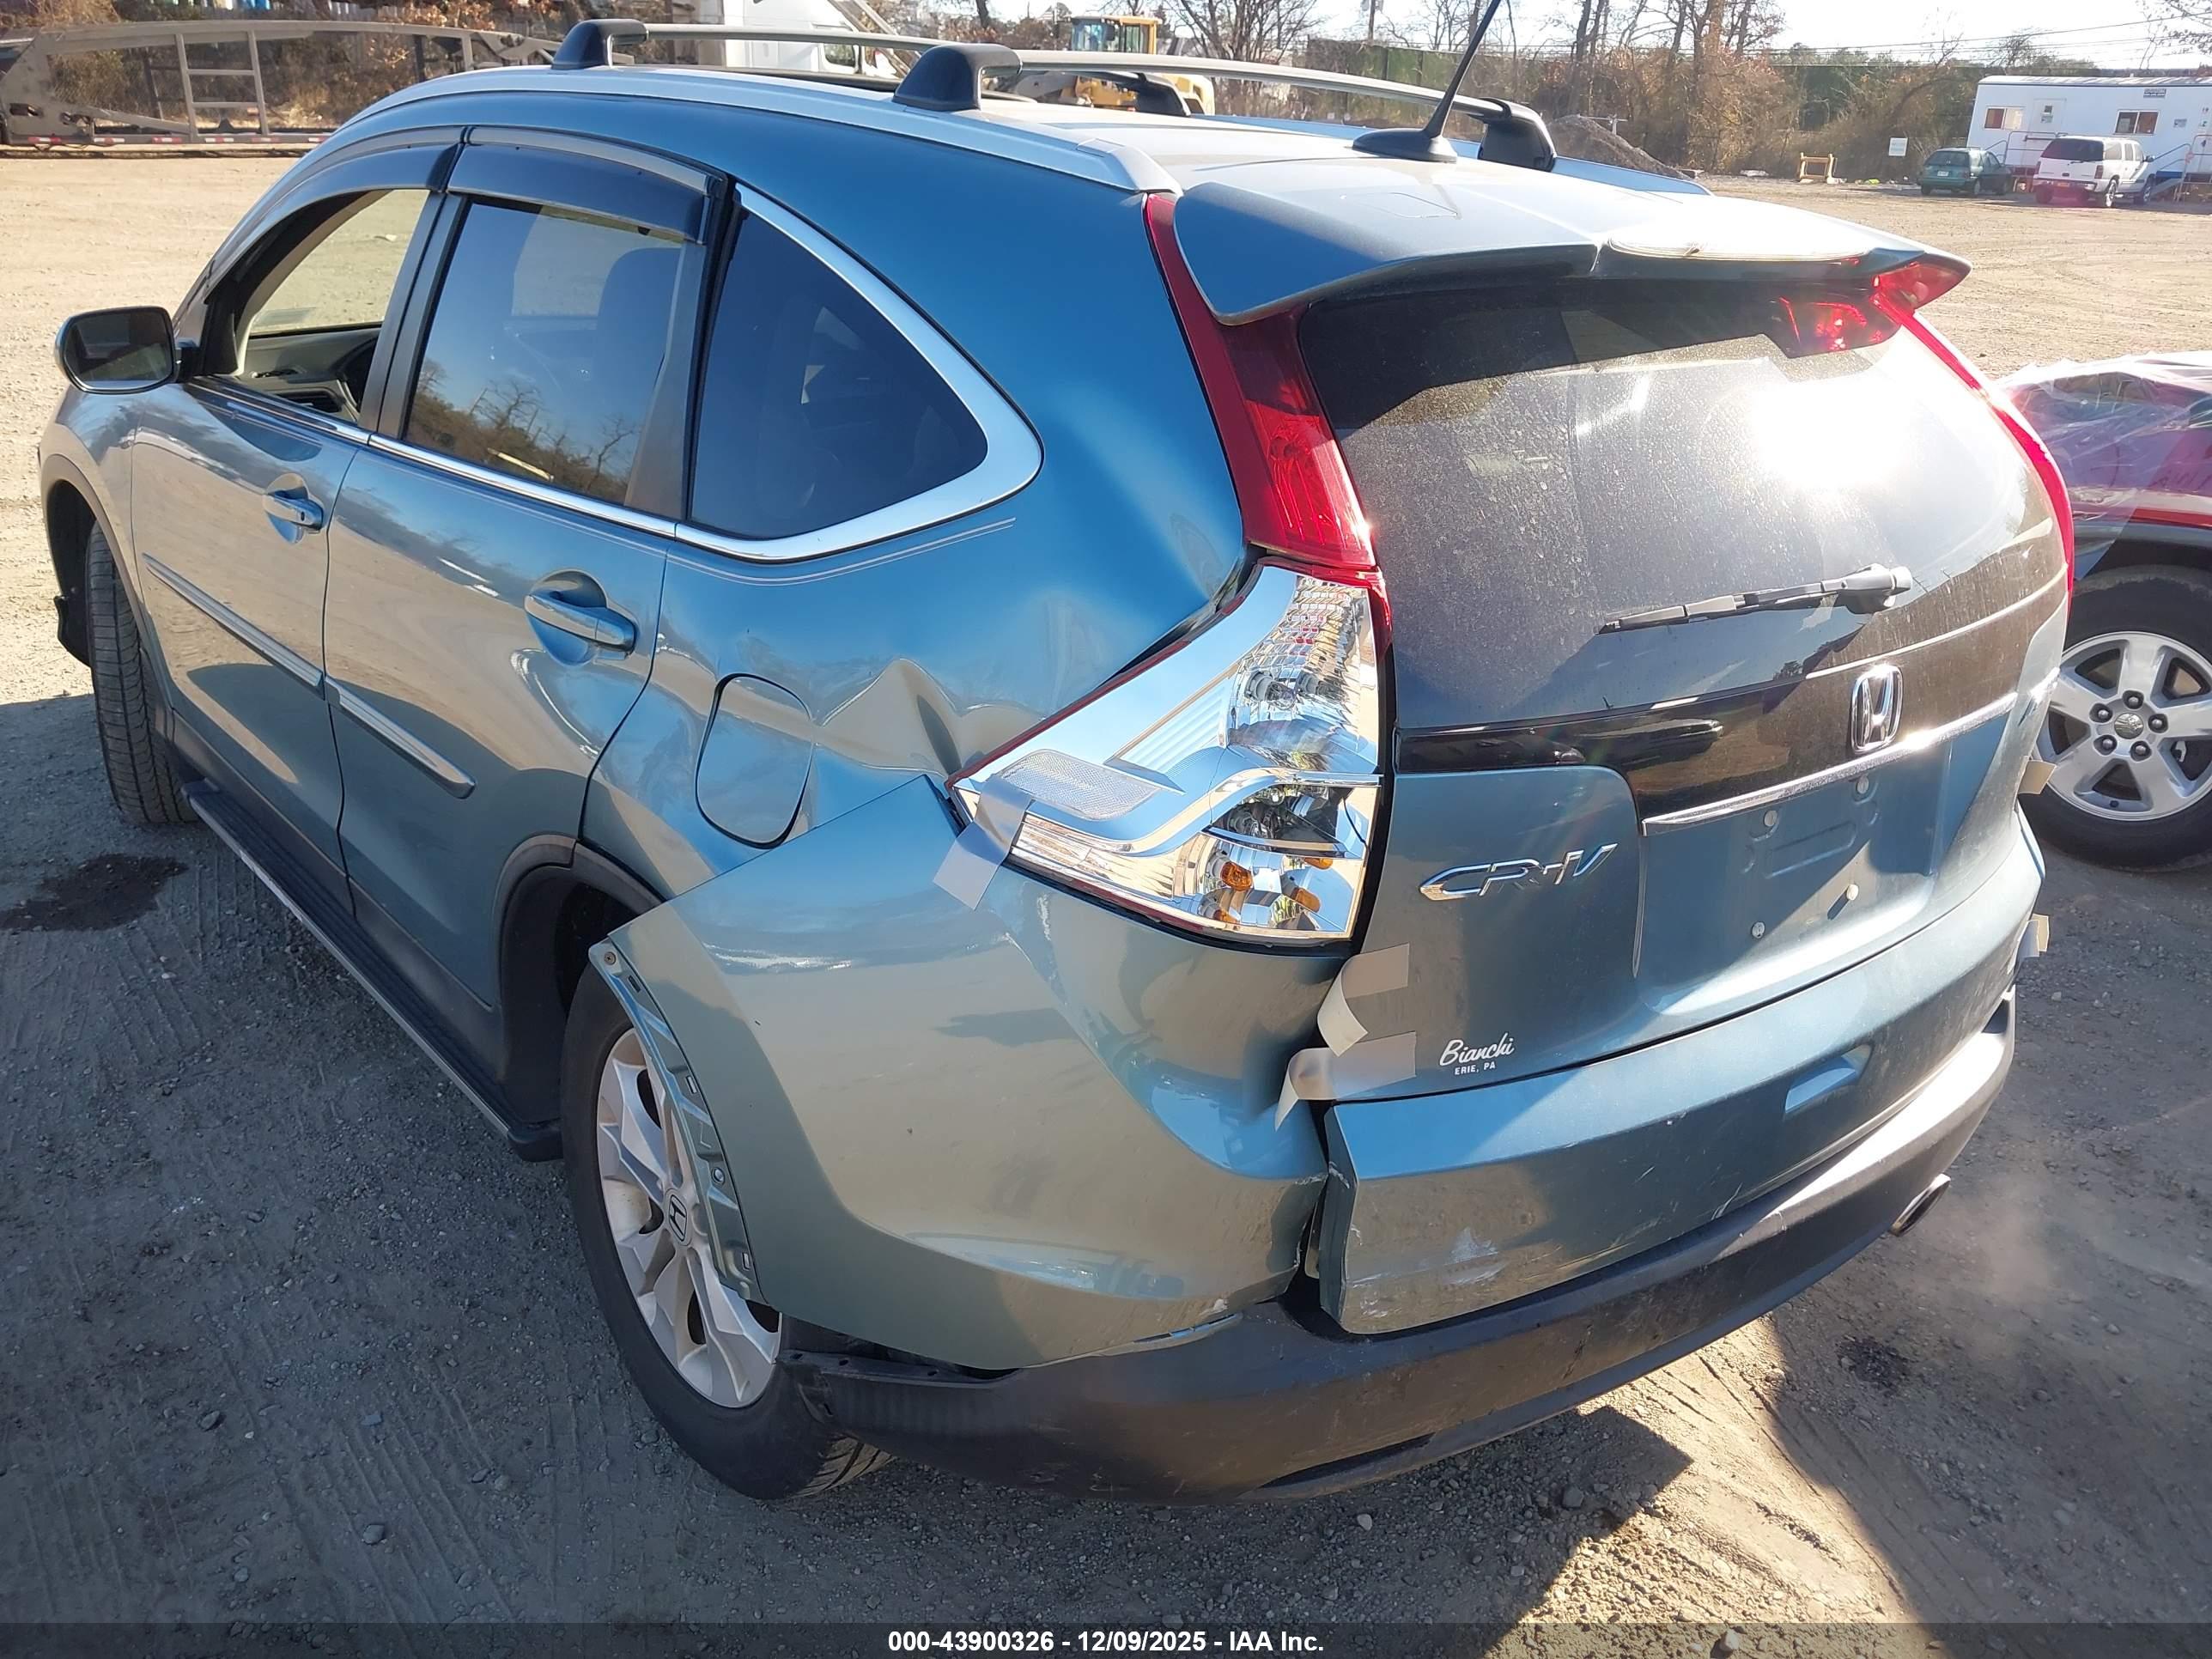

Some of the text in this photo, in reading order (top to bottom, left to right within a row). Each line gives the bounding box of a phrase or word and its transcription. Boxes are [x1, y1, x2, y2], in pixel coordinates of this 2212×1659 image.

[1419, 843, 1618, 900] CR-V
[1439, 1032, 1515, 1066] Bianchi
[1455, 1061, 1496, 1075] ERIE, PA
